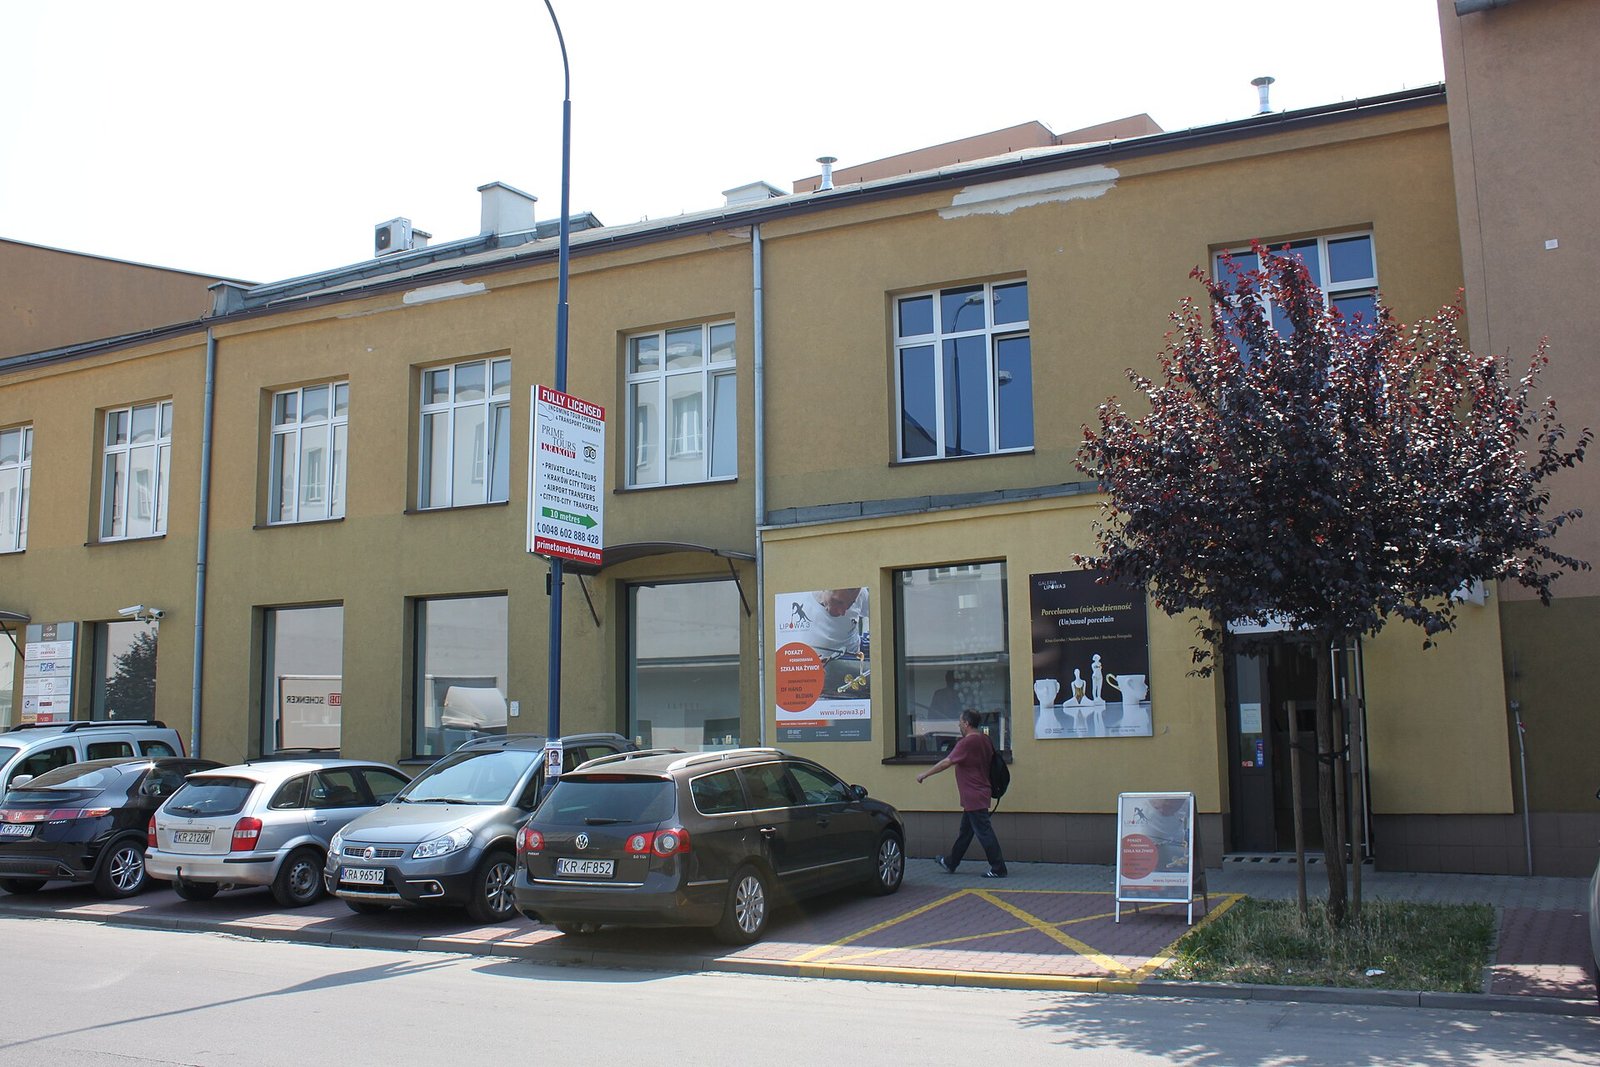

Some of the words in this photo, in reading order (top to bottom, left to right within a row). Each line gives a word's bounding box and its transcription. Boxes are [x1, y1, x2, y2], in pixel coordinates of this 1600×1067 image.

[542, 389, 565, 406] FULLY
[568, 398, 602, 418] LICENSED
[548, 404, 570, 416] INCOMING
[570, 411, 581, 420] TOUR
[581, 415, 601, 426] OPERATOR
[541, 424, 565, 440] PRIME
[559, 416, 582, 428] TRANSPORT
[582, 423, 601, 434] COMPANY
[553, 436, 576, 452] TOURS
[545, 462, 565, 474] PRIVATE
[566, 468, 581, 478] LOCAL
[582, 472, 597, 482] TOURS
[547, 484, 568, 495] AIRPORT
[568, 489, 596, 502] TRANSFERS
[569, 479, 580, 488] CITY
[580, 482, 596, 492] TOURS
[573, 500, 599, 512] TRANSFERS
[550, 509, 559, 519] 10
[560, 512, 580, 524] metres
[542, 524, 558, 536] 0048
[560, 528, 572, 539] 602
[574, 530, 586, 542] 888
[587, 534, 599, 545] 428
[536, 540, 601, 560] primetourskrakow.com
[1041, 608, 1079, 616] Porcelanowa
[1058, 617, 1086, 626] (Un)usual
[1087, 616, 1114, 626] porcelain
[820, 708, 866, 717] www.lipowa3.pl
[178, 833, 187, 842] KR
[344, 869, 358, 880] KRA
[360, 870, 384, 881] 96512
[563, 861, 578, 873] KR
[580, 862, 611, 874] 4F852
